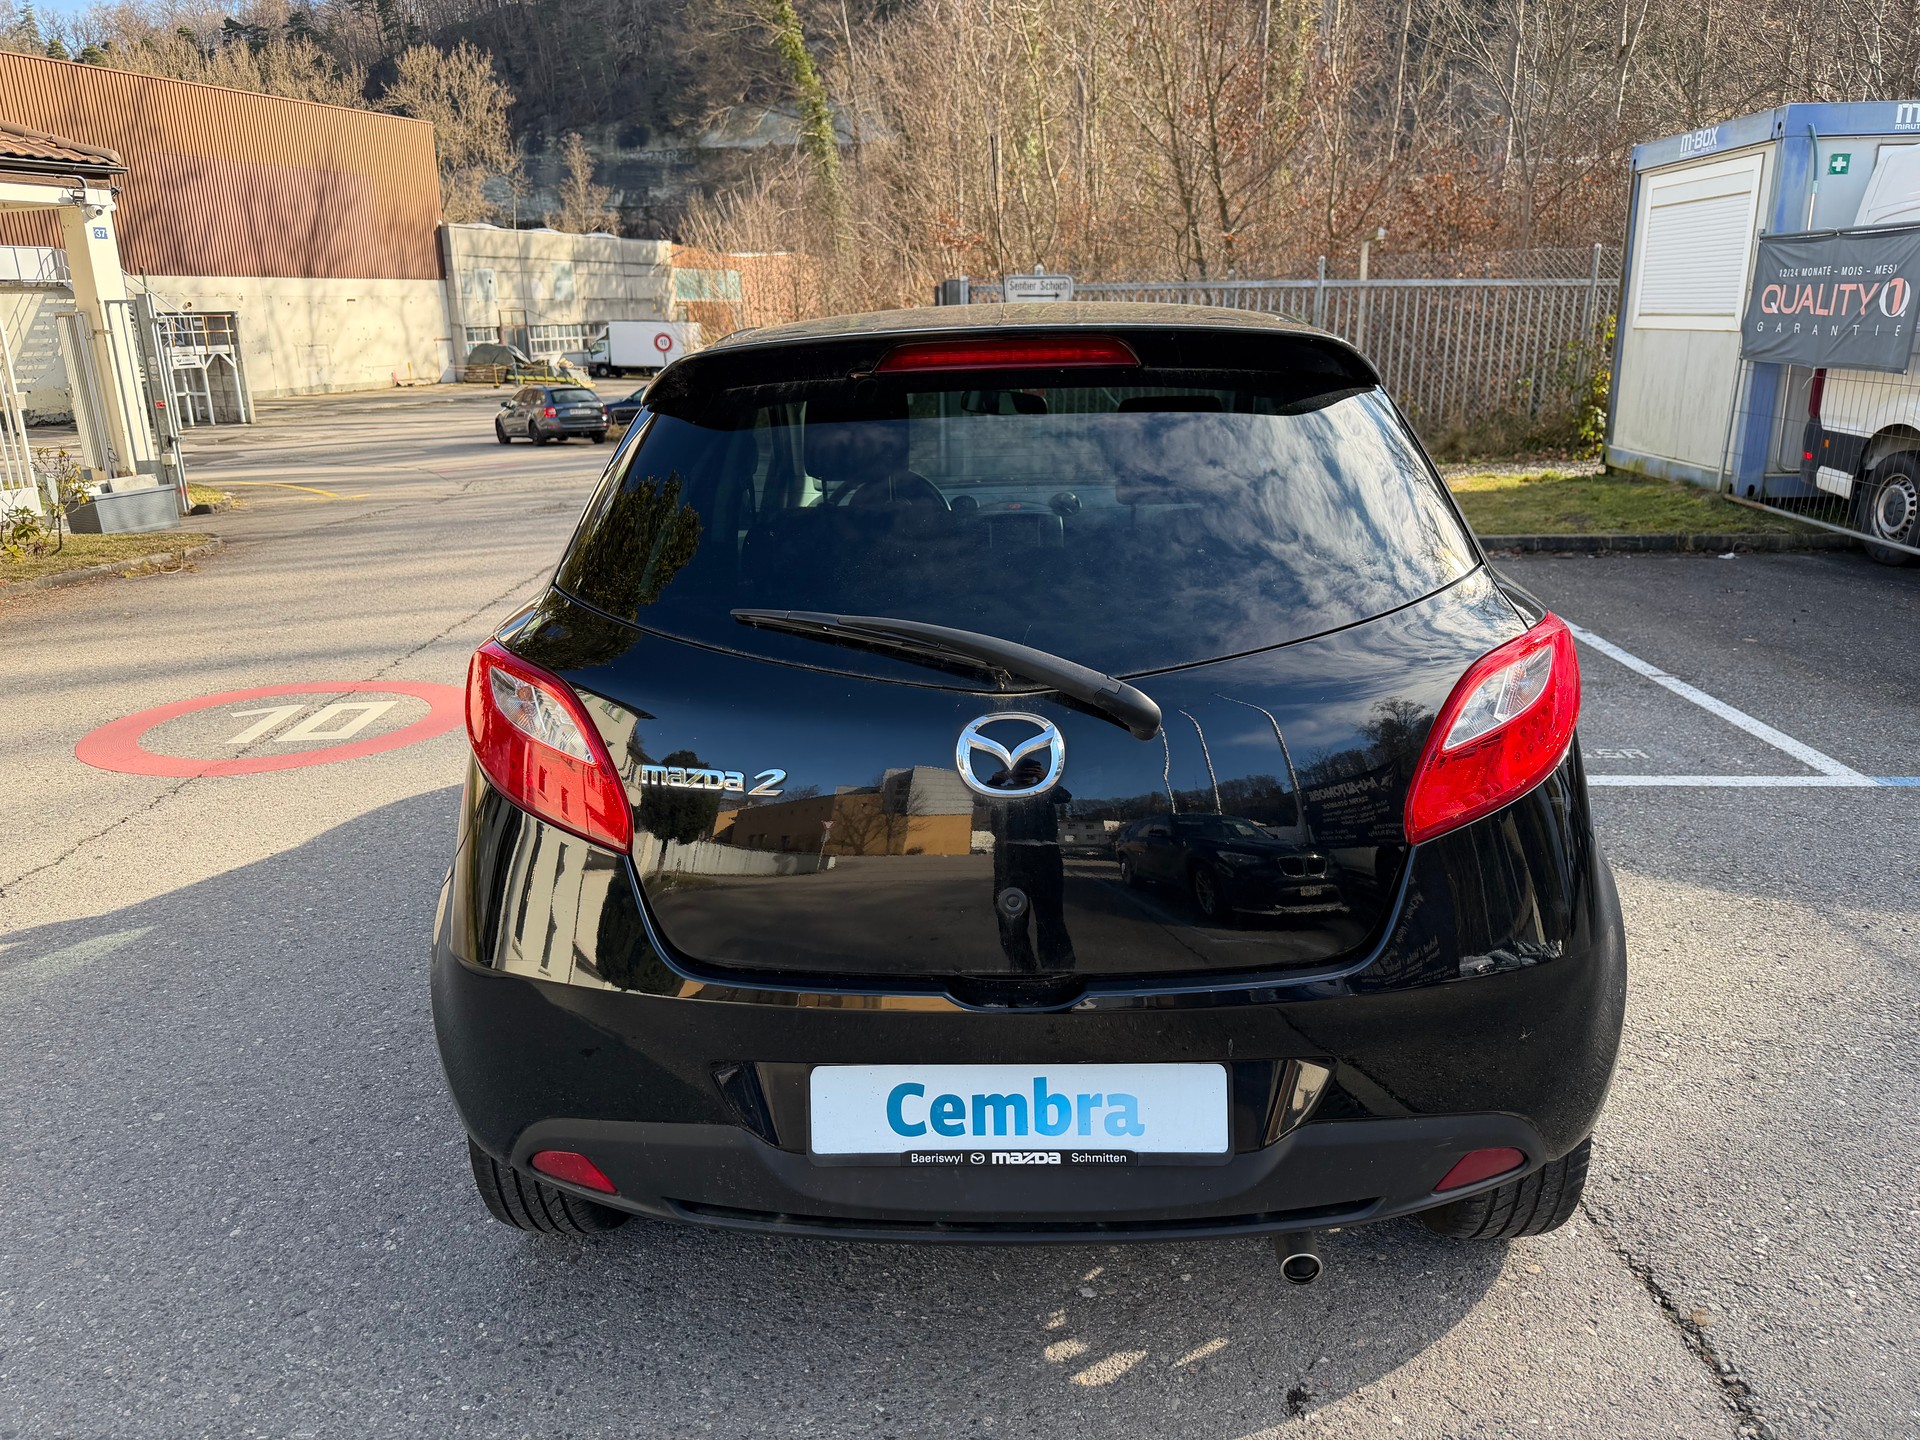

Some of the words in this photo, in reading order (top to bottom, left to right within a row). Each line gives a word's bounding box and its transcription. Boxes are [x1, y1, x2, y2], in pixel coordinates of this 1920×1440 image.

[94, 228, 106, 238] 37
[1779, 268, 1798, 277] 12/24
[1801, 266, 1831, 276] MONATE
[1841, 265, 1863, 276] MOIS
[1761, 283, 1880, 316] QUALITY
[1756, 321, 1902, 337] GARANTIE
[659, 338, 668, 347] 10
[225, 701, 399, 744] 10
[641, 765, 745, 792] mazda
[748, 768, 787, 796] 2
[886, 1076, 1146, 1137] Cembra
[911, 1153, 963, 1163] Baeriswyl
[991, 1152, 1061, 1165] mazda
[1071, 1152, 1127, 1163] Schmitten
